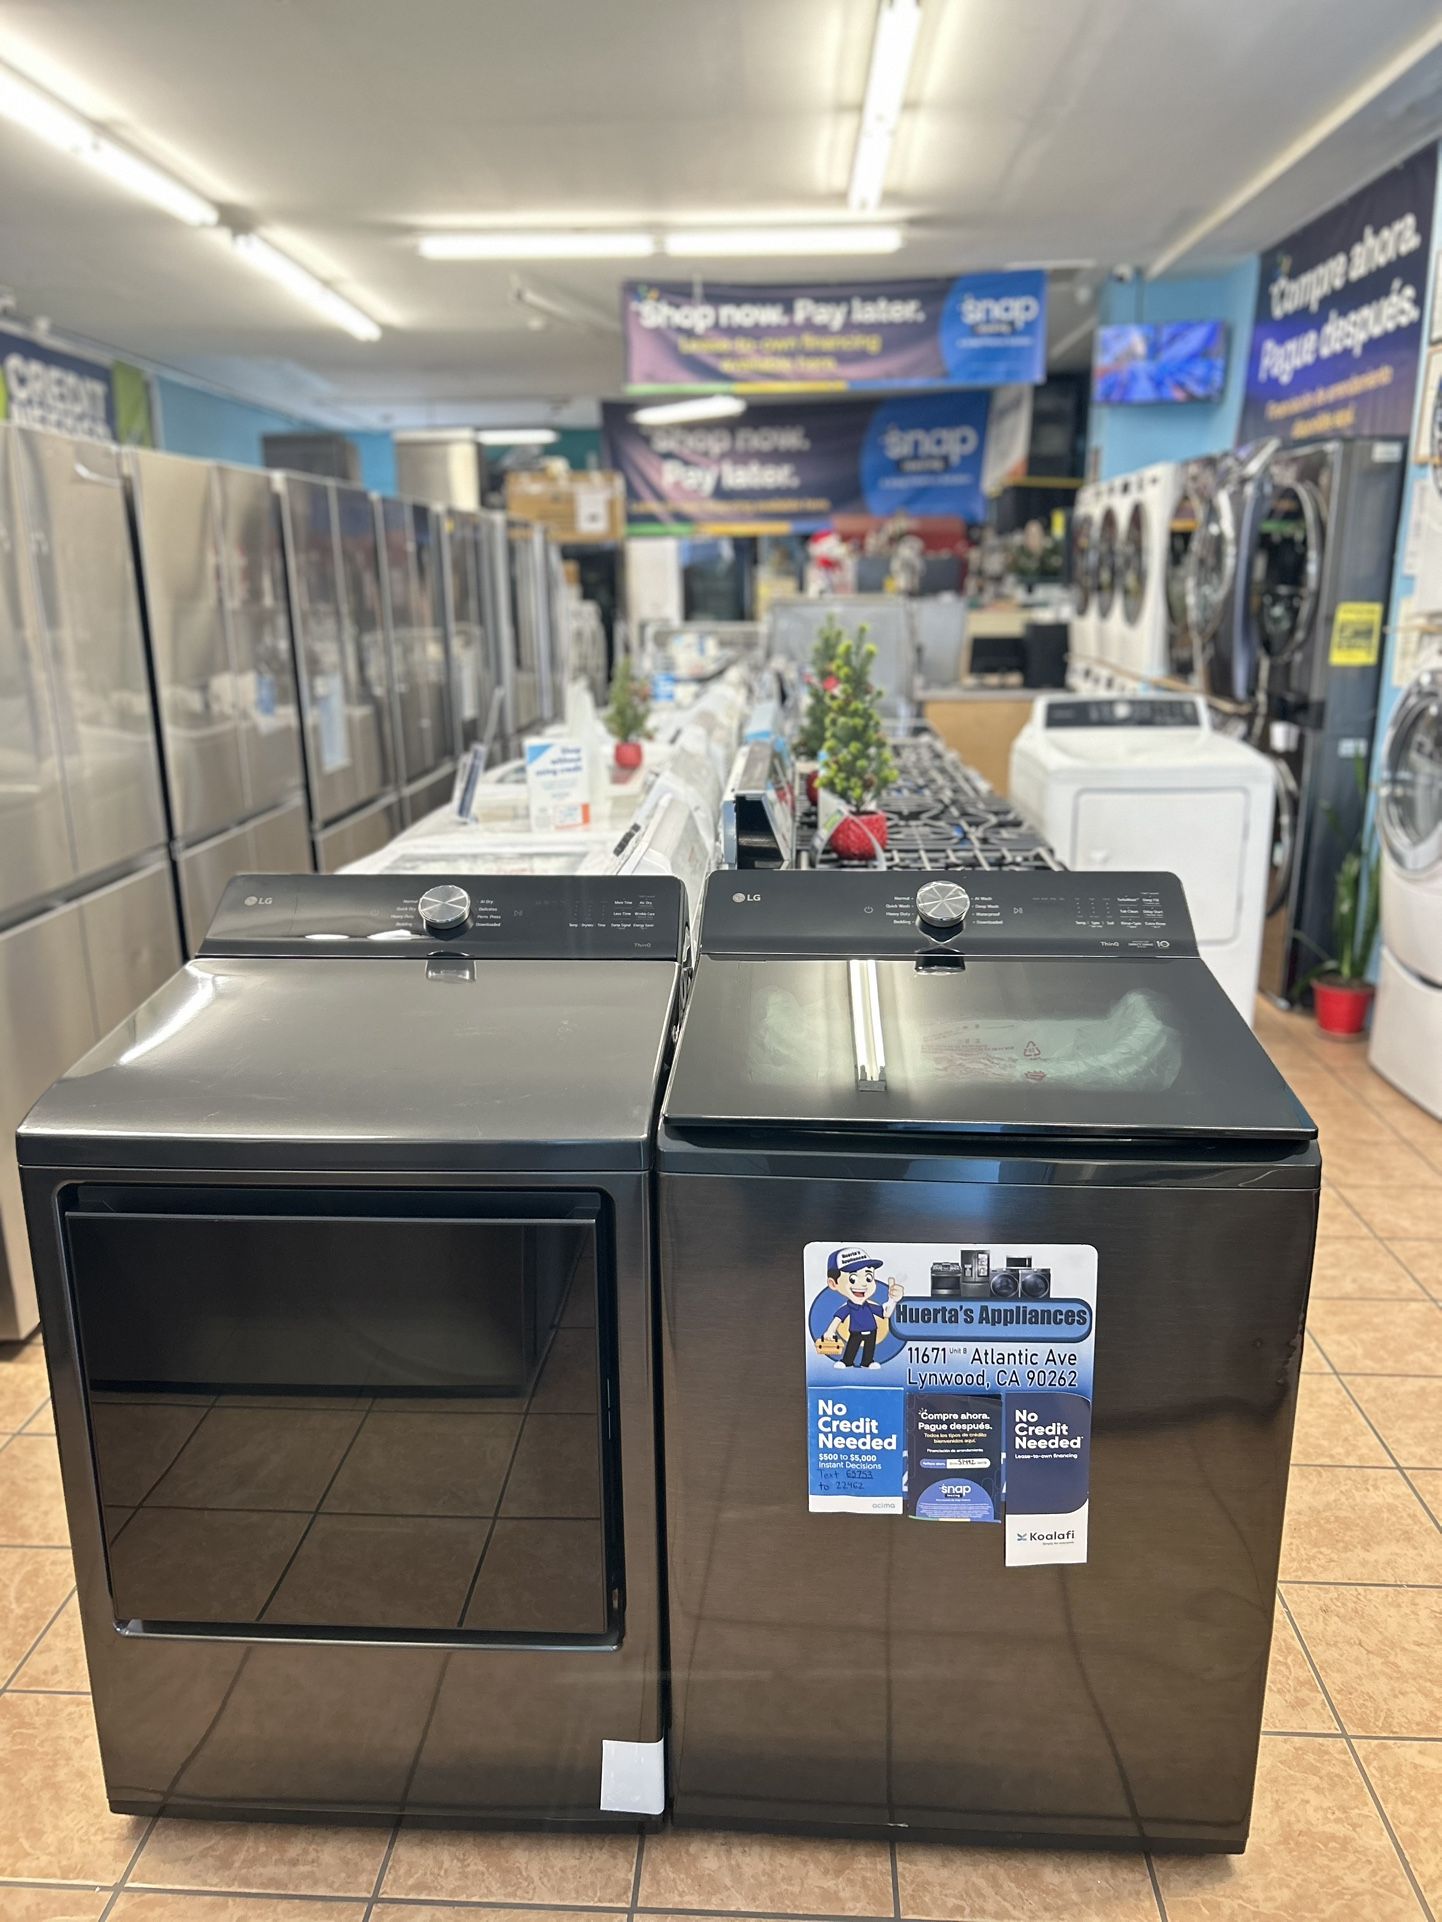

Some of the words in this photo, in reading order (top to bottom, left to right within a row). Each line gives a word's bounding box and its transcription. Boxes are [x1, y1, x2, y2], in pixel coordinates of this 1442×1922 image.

[1269, 253, 1347, 320] Compre
[1349, 212, 1421, 282] ahora.
[640, 299, 715, 334] Shop
[718, 303, 789, 328] now.
[793, 298, 847, 332] Pay
[851, 297, 926, 325] later.
[960, 296, 1039, 330] snap
[1258, 330, 1317, 386] Pague
[734, 425, 811, 451] now.
[885, 425, 979, 466] snap
[661, 459, 718, 496] Pay
[721, 459, 800, 489] later.
[258, 897, 273, 905] LG
[747, 894, 761, 902] LG
[896, 1304, 974, 1325] Huerta's
[978, 1305, 1088, 1327] Appliances
[907, 1346, 947, 1364] 11671
[971, 1347, 1039, 1365] Atlantic
[1045, 1349, 1077, 1366] Ave
[908, 1368, 990, 1389] Lynwood,
[996, 1370, 1020, 1387] CA
[1026, 1370, 1077, 1387] 90262
[818, 1399, 848, 1416] No
[1015, 1410, 1039, 1422] No
[817, 1416, 879, 1434] Credit
[920, 1412, 959, 1421] Compre
[960, 1412, 990, 1420] ahora.
[918, 1422, 948, 1432] Pague
[950, 1422, 993, 1432] después.
[1014, 1422, 1068, 1436] Credit
[818, 1433, 897, 1450] Needed
[1015, 1436, 1082, 1449] Needed
[818, 1453, 838, 1461] $500
[850, 1454, 877, 1462] $5,000
[846, 1462, 882, 1470] Decisions
[818, 1482, 830, 1490] to
[940, 1484, 972, 1496] snap
[1030, 1530, 1075, 1541] Koalafi
